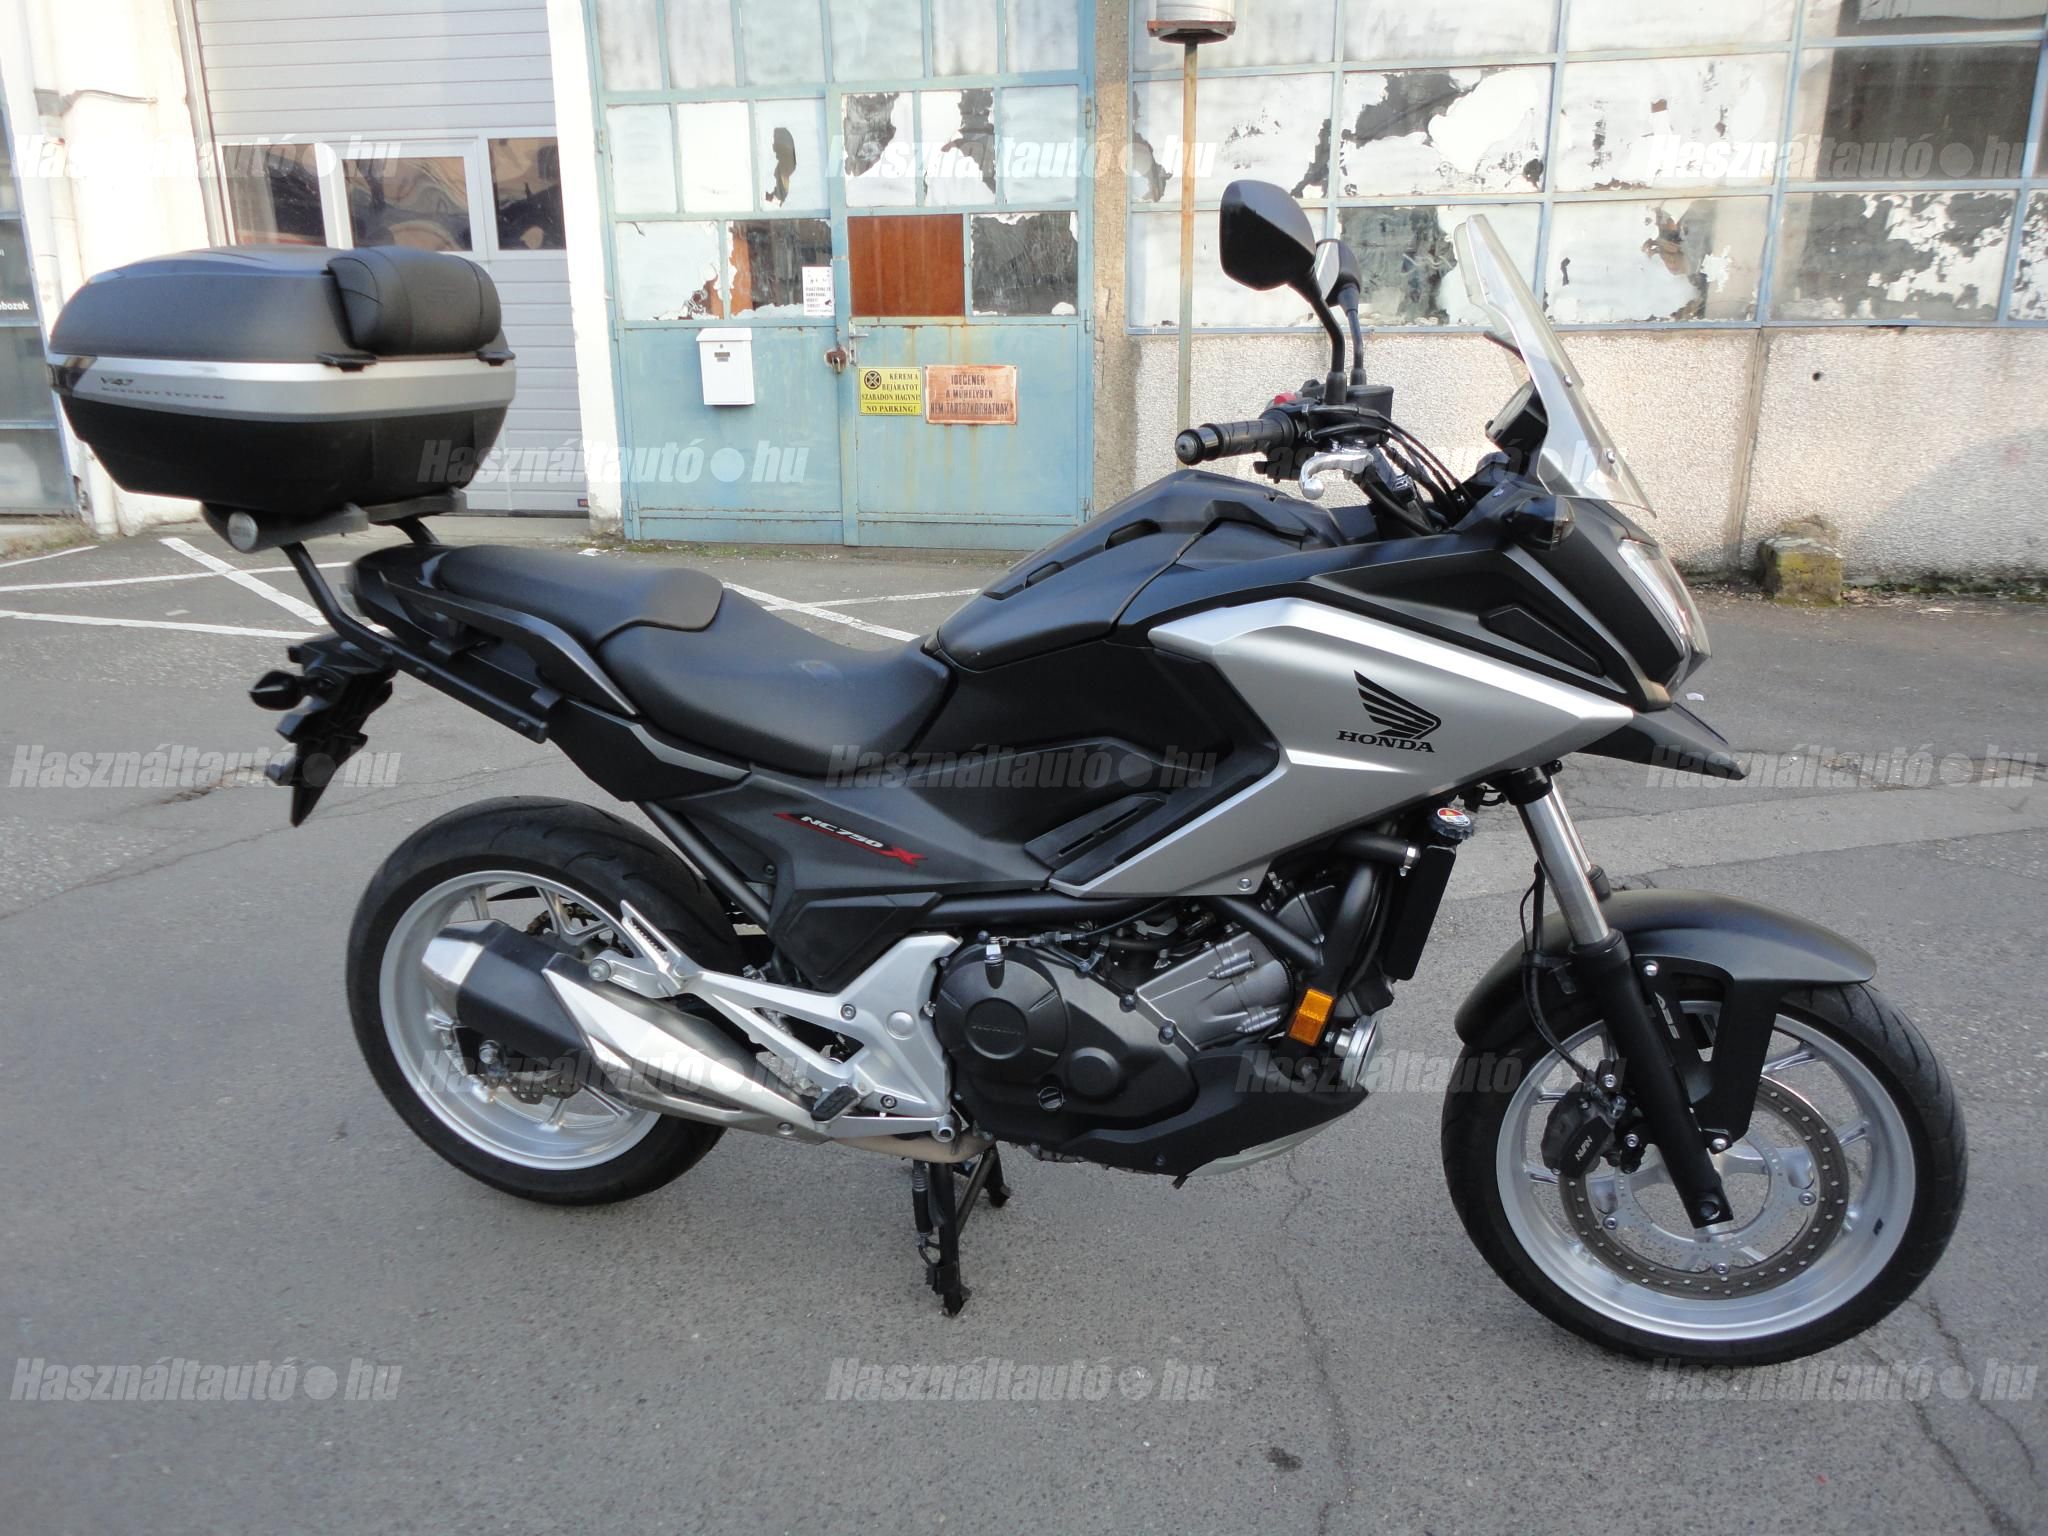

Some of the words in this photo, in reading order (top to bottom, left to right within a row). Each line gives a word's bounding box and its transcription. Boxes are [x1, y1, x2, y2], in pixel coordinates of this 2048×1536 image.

[0, 301, 29, 310] bozok
[880, 405, 916, 413] PARKING!
[1336, 730, 1436, 753] HONDA
